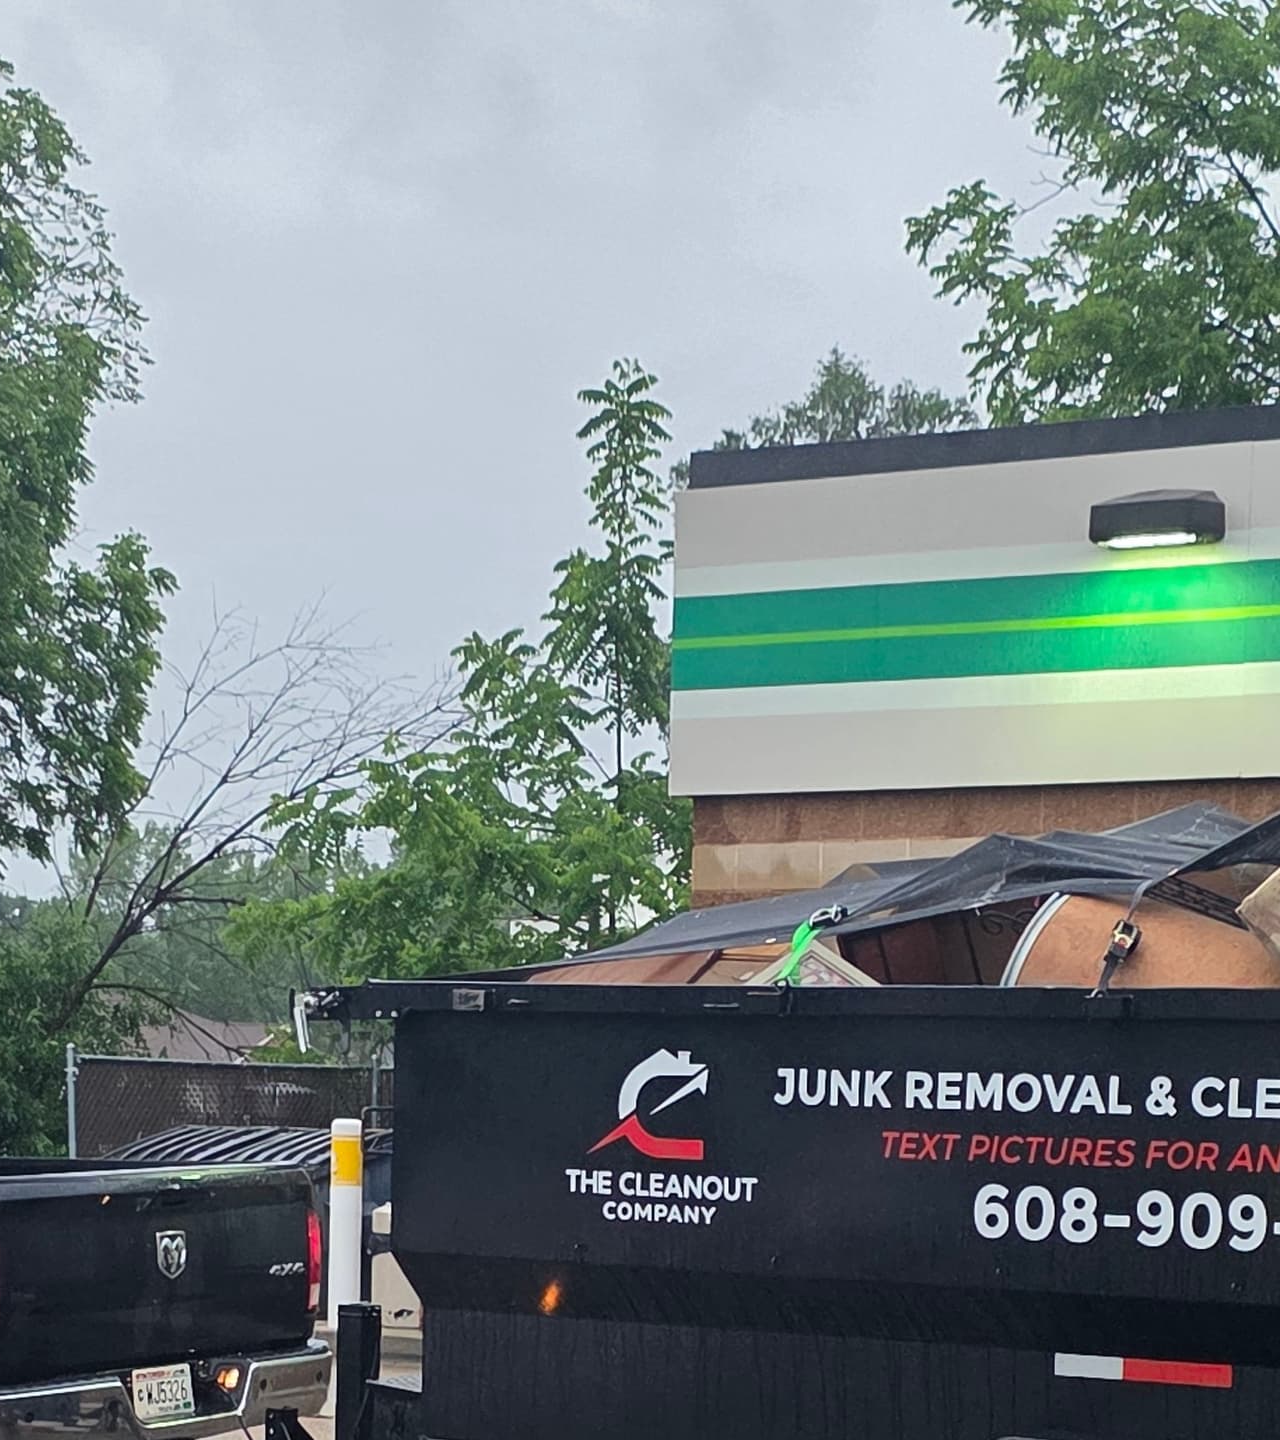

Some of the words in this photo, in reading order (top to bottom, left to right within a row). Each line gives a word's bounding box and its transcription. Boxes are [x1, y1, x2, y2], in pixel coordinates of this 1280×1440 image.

[773, 1067, 894, 1109] JUNK
[904, 1070, 1133, 1115] REMOVAL
[1144, 1075, 1178, 1117] &
[881, 1130, 962, 1161] TEXT
[967, 1134, 1137, 1168] PICTURES
[1145, 1140, 1220, 1171] FOR
[564, 1168, 613, 1196] THE
[618, 1171, 759, 1203] CLEANOUT
[601, 1200, 717, 1225] COMPANY
